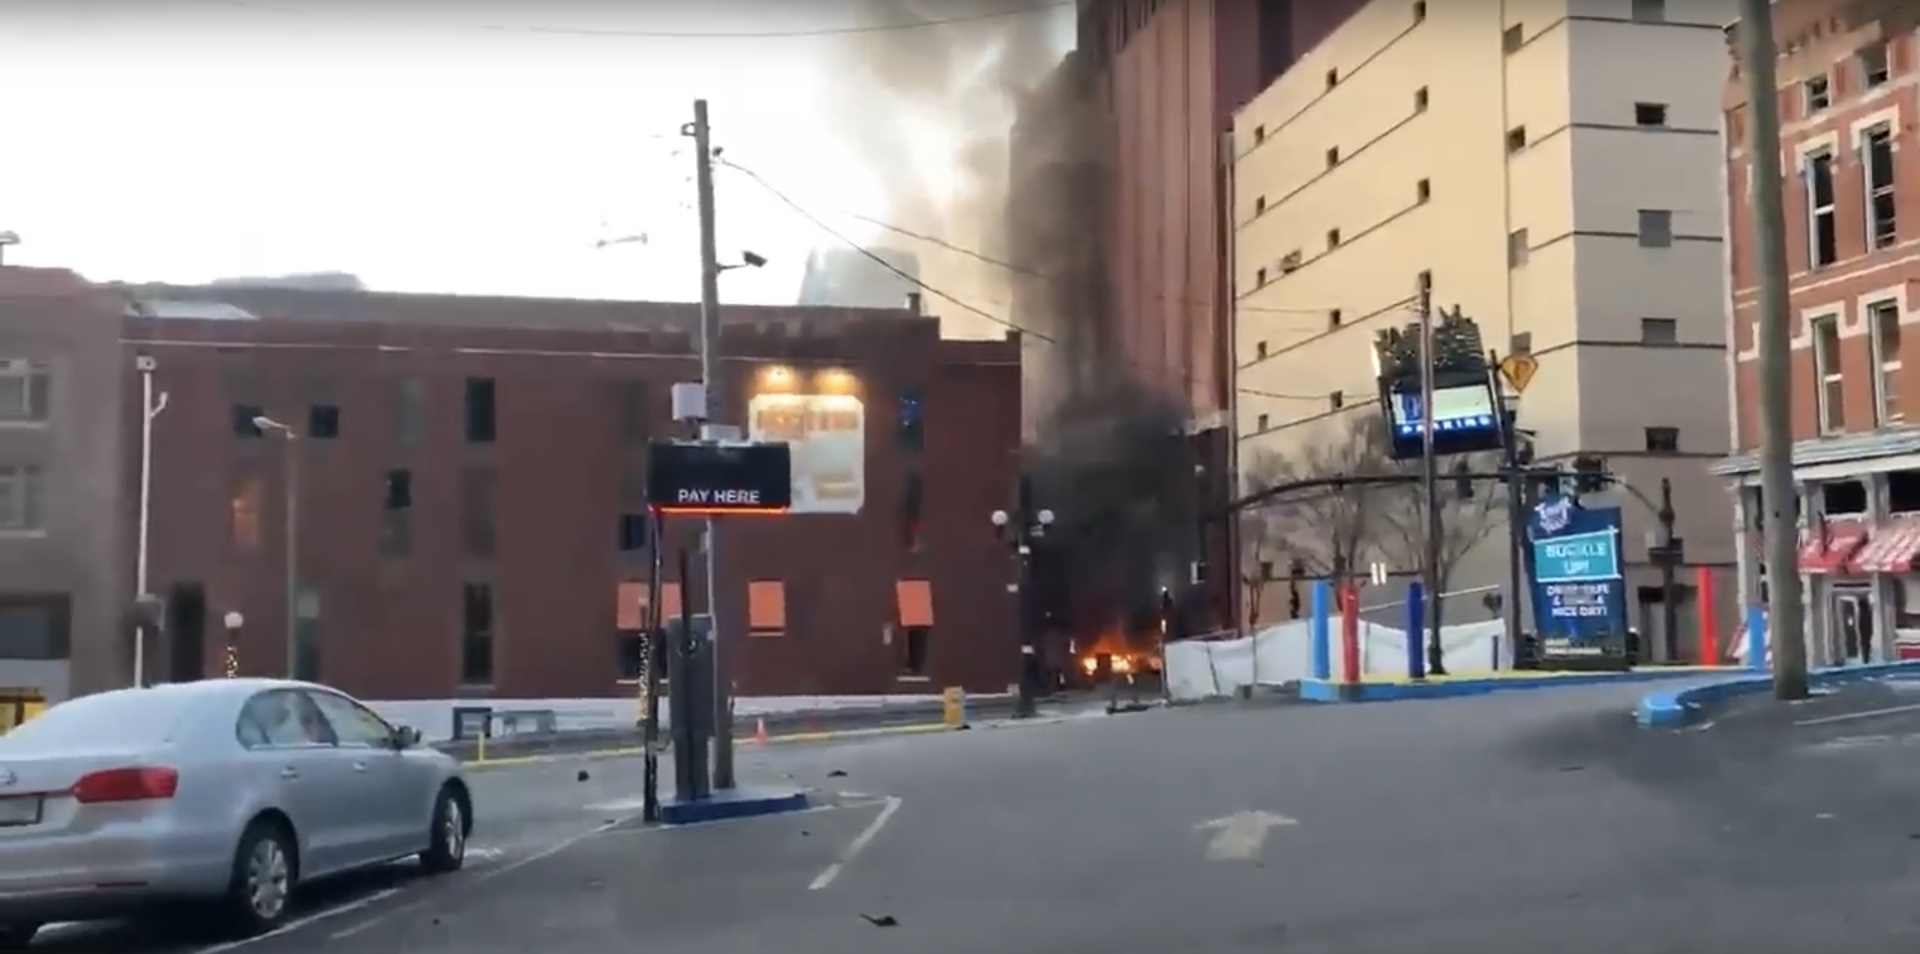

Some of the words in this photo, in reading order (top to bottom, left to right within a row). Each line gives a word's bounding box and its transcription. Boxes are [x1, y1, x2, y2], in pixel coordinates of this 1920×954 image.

[1402, 416, 1491, 435] PARKING
[678, 489, 710, 502] PAY
[714, 489, 760, 503] HERE
